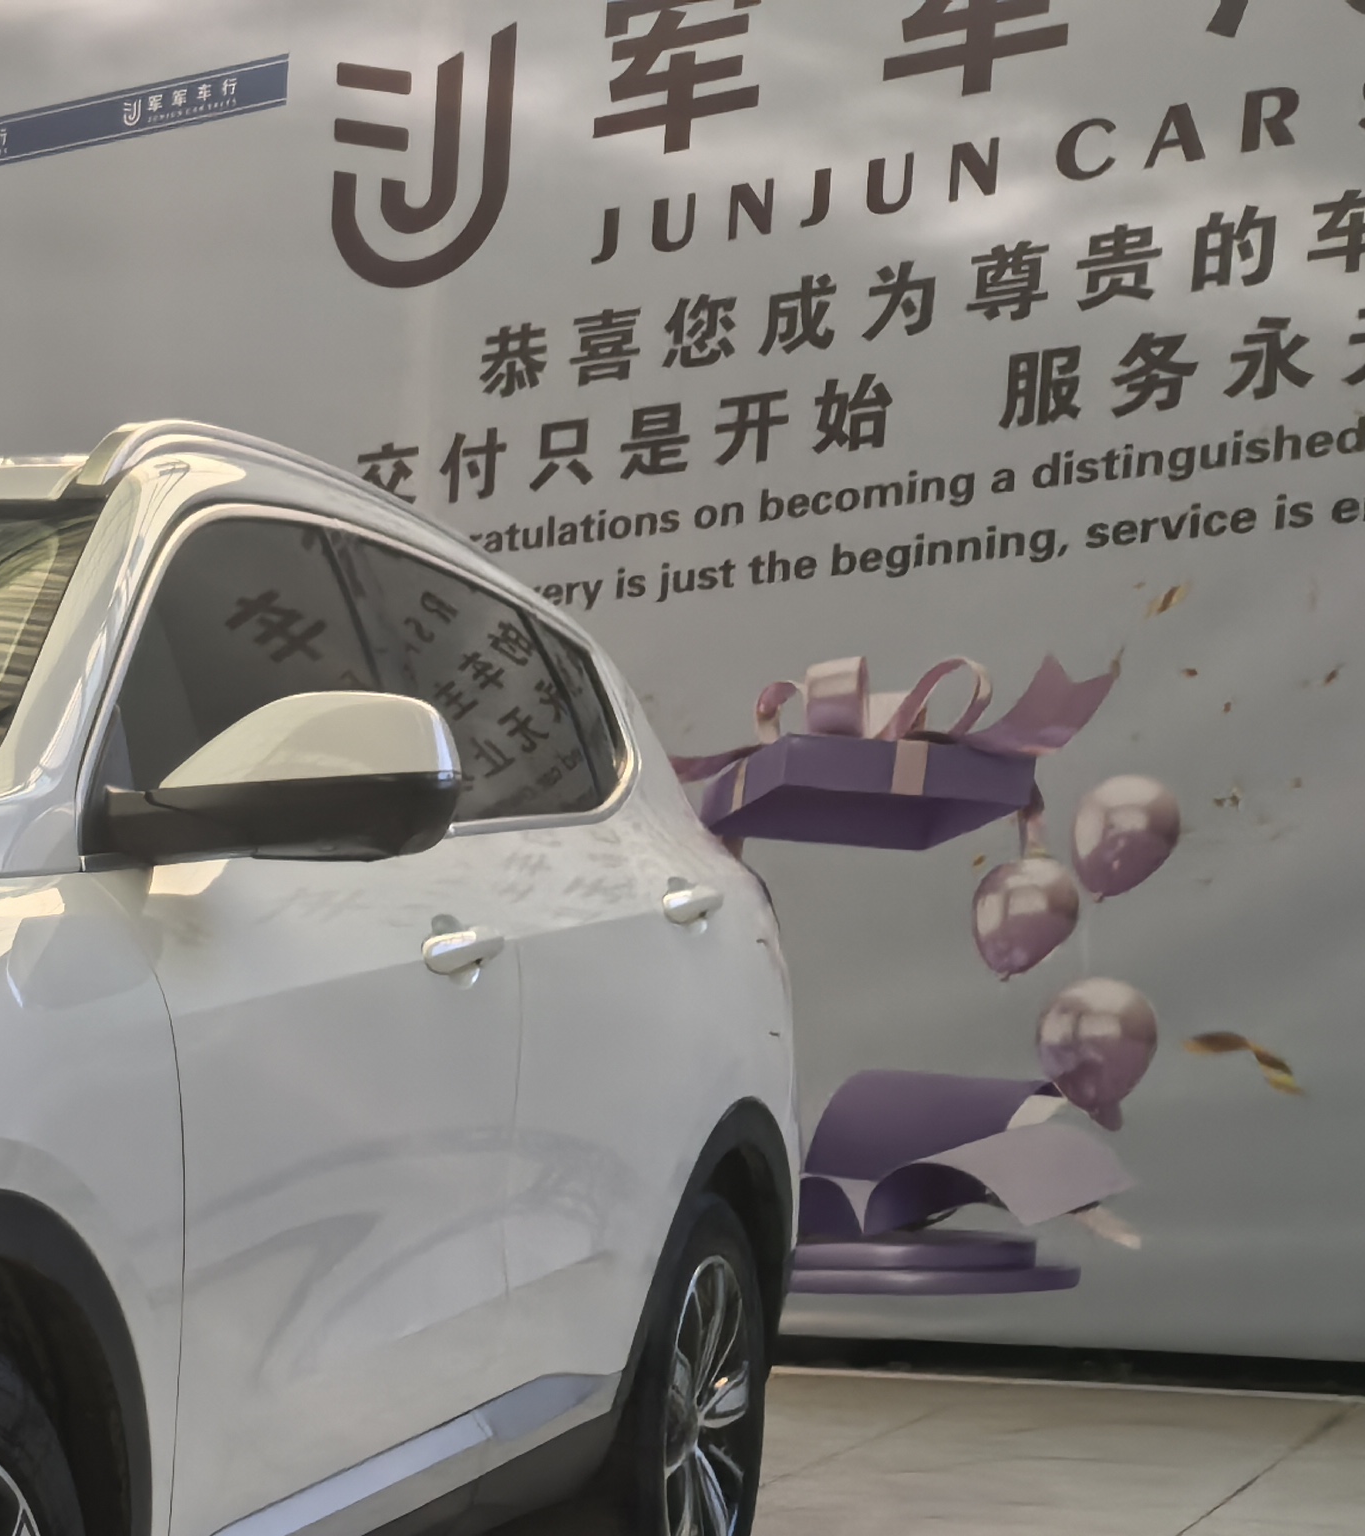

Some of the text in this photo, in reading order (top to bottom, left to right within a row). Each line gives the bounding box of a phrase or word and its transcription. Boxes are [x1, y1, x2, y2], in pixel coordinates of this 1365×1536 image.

[591, 137, 999, 265] JUNJUN
[1056, 87, 1300, 181] CAR
[357, 374, 893, 504] 交付只是开始
[694, 499, 744, 530] on
[759, 470, 975, 523] becoming
[990, 466, 1016, 494] a
[1032, 416, 1365, 490] distinguished
[534, 579, 603, 611] ery
[616, 566, 647, 600] is
[656, 558, 736, 603] just
[748, 550, 818, 585] the
[831, 525, 1069, 579] beginning,
[1085, 503, 1257, 549] service
[1274, 494, 1314, 530] is
